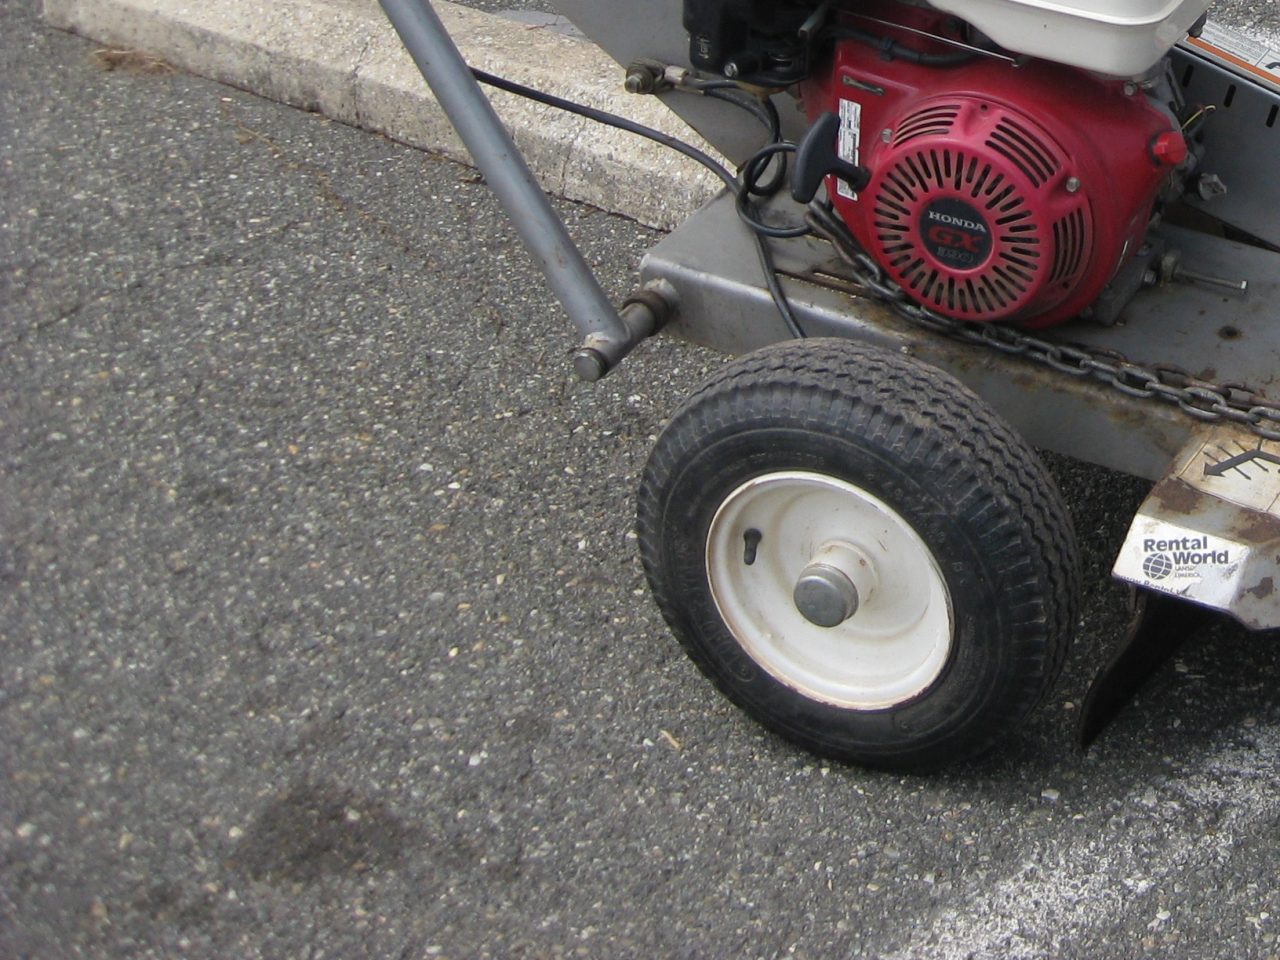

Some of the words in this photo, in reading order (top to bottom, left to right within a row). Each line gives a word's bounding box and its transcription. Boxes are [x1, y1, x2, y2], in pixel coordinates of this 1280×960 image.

[928, 210, 987, 233] HONDA
[1143, 536, 1208, 553] Rental
[1173, 550, 1229, 565] World
